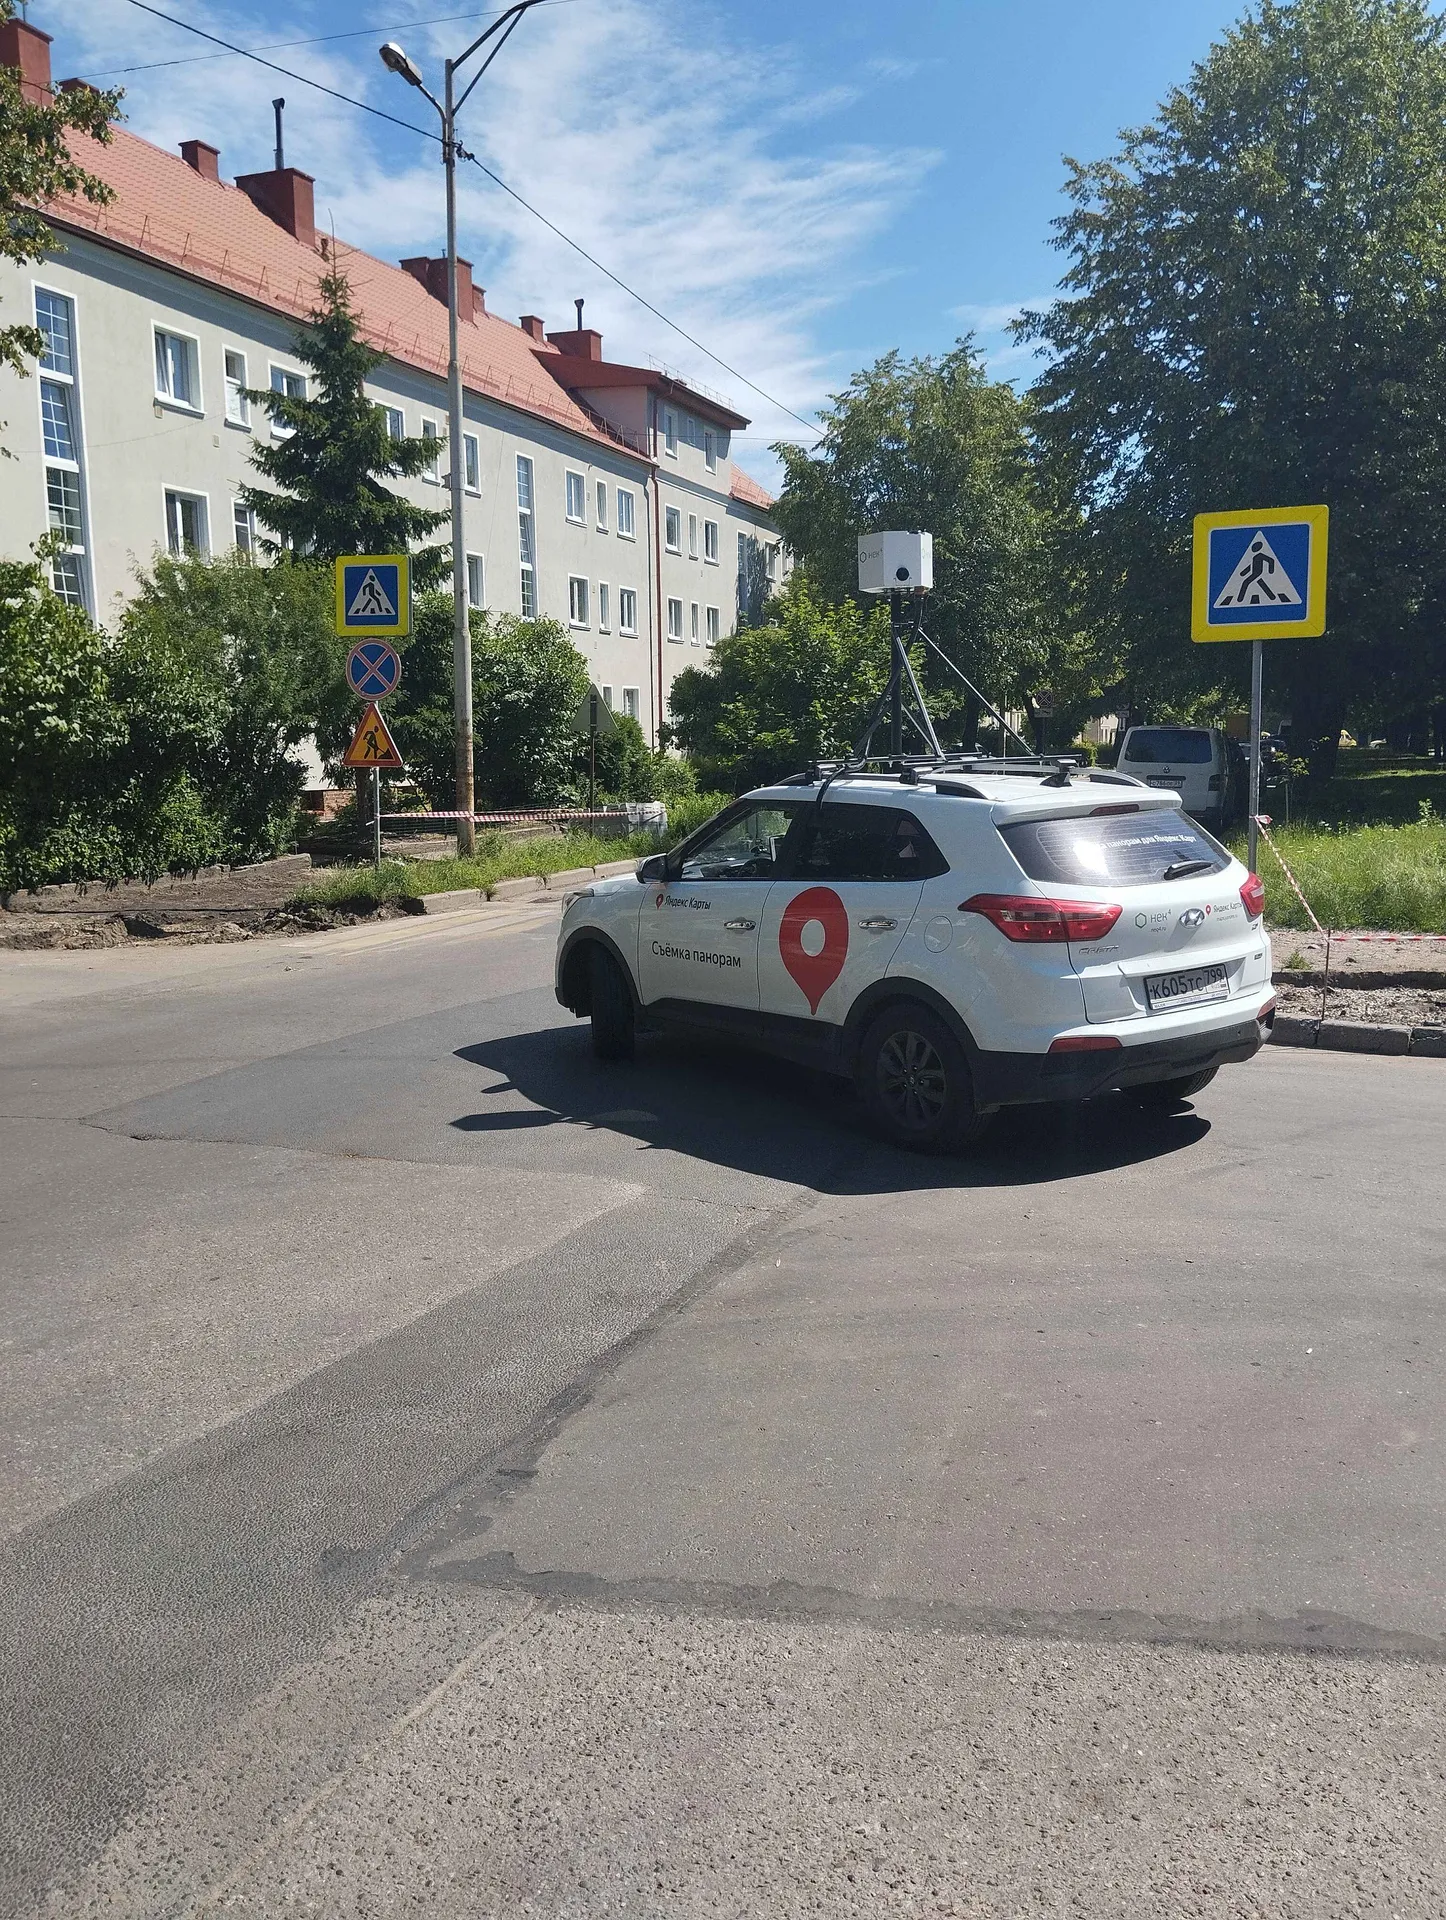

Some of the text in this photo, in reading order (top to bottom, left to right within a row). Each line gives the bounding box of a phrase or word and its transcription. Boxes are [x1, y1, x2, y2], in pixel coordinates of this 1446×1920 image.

[664, 895, 712, 910] Яндекс Карты
[651, 940, 741, 968] Съёмка панорам
